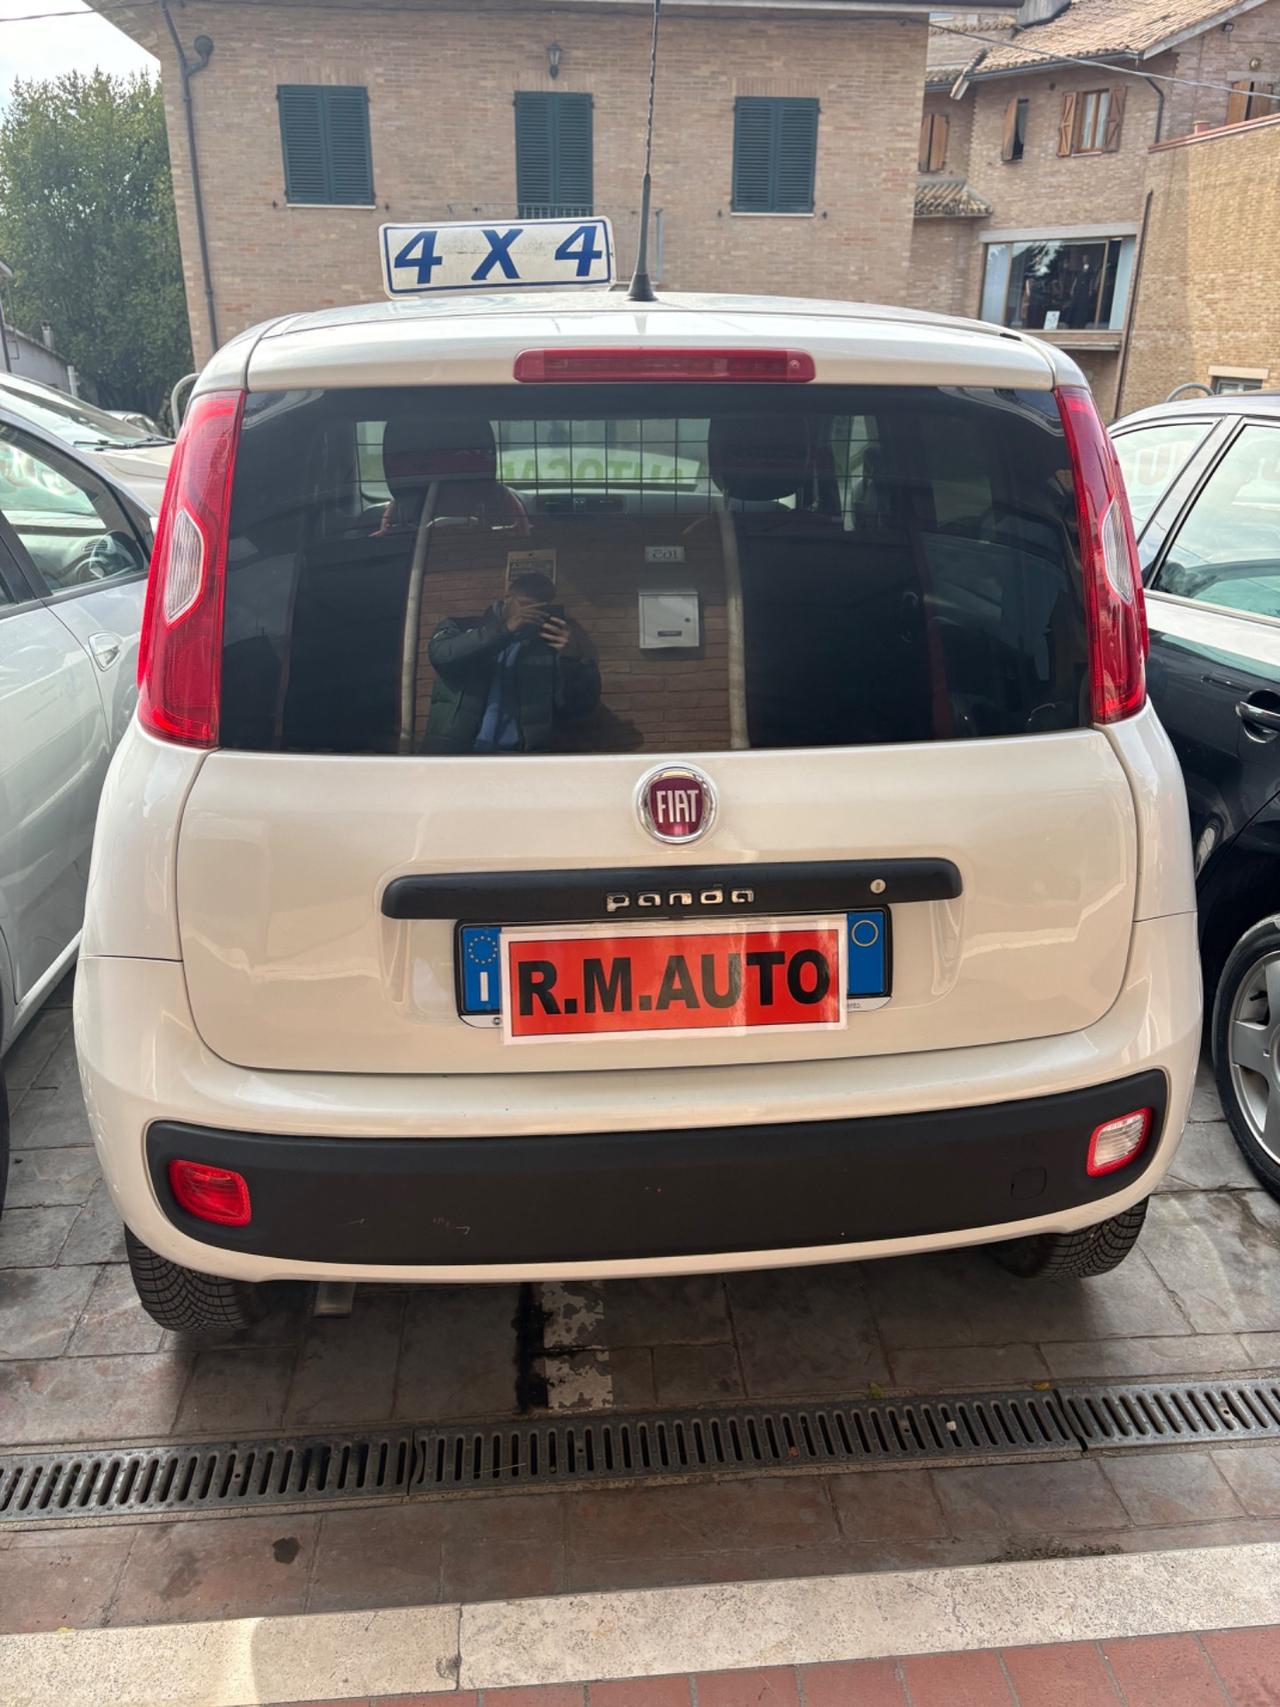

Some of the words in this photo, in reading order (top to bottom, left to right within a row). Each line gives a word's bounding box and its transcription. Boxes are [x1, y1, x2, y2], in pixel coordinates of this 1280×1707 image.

[394, 230, 443, 284] 4
[554, 226, 603, 277] 4
[656, 789, 699, 823] FIAT
[606, 884, 754, 912] panda
[479, 971, 489, 1002] I
[517, 948, 831, 1017] R.M.AUTO
